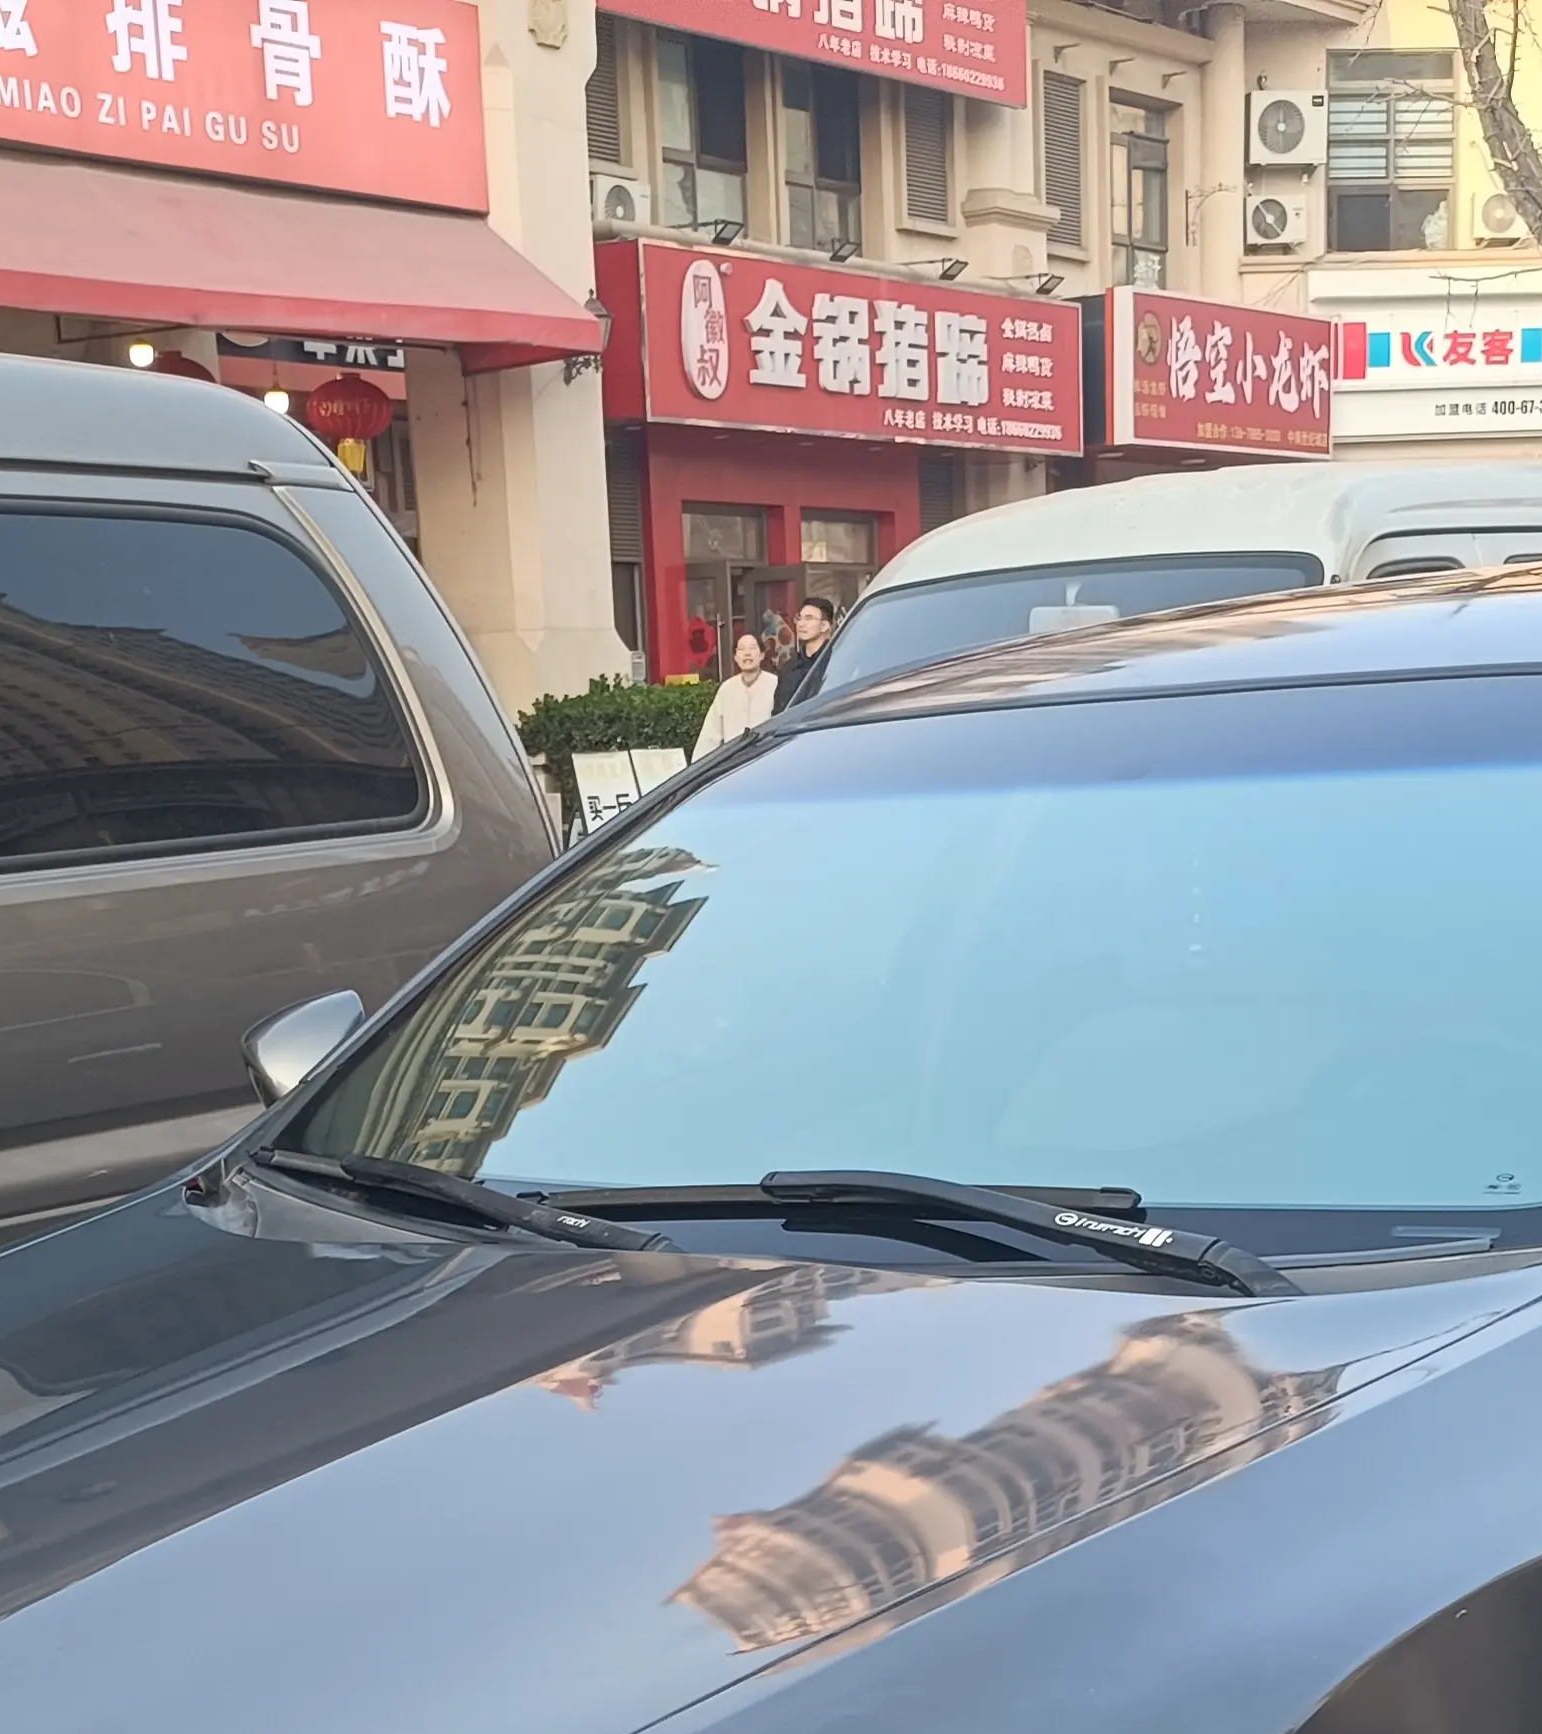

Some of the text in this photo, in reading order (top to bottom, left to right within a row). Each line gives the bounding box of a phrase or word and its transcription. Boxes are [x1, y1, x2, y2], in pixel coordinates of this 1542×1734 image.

[97, 93, 127, 127] ZI
[141, 100, 192, 137] PAI
[205, 111, 248, 145] GU
[261, 120, 302, 154] SU
[742, 278, 991, 407] 金锅猪蹄
[1167, 315, 1330, 420] 悟空小龙虾
[1442, 329, 1514, 366] 友客
